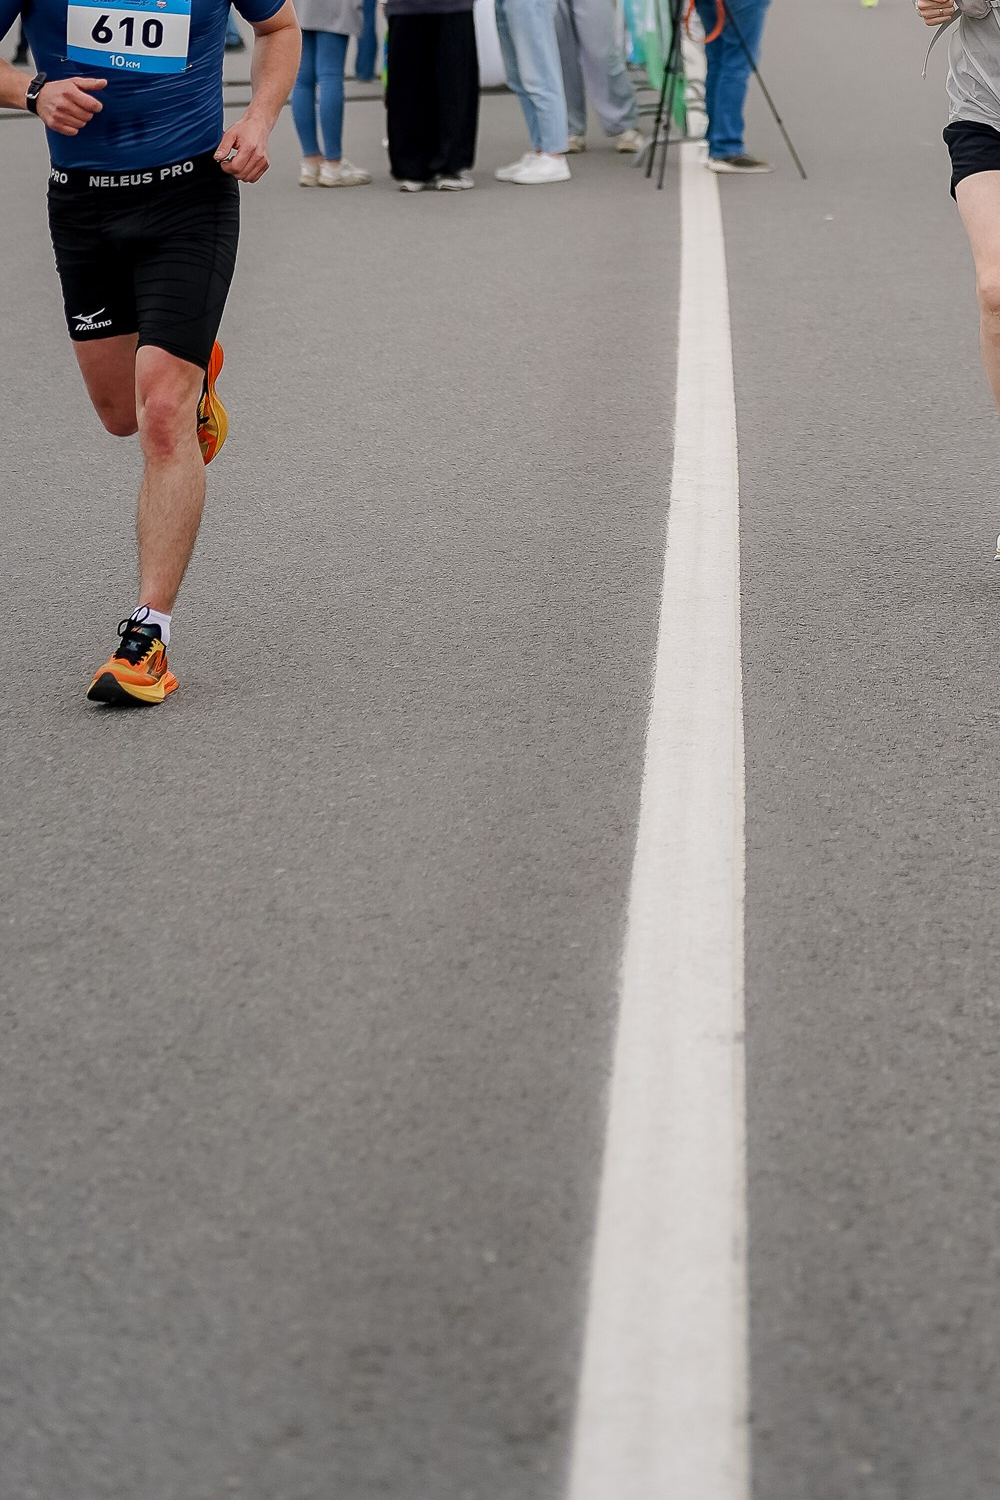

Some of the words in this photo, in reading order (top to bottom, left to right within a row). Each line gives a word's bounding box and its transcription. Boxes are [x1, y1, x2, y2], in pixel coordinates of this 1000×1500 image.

[91, 14, 164, 49] 610
[89, 172, 153, 187] NELEUS
[160, 161, 194, 181] PRO
